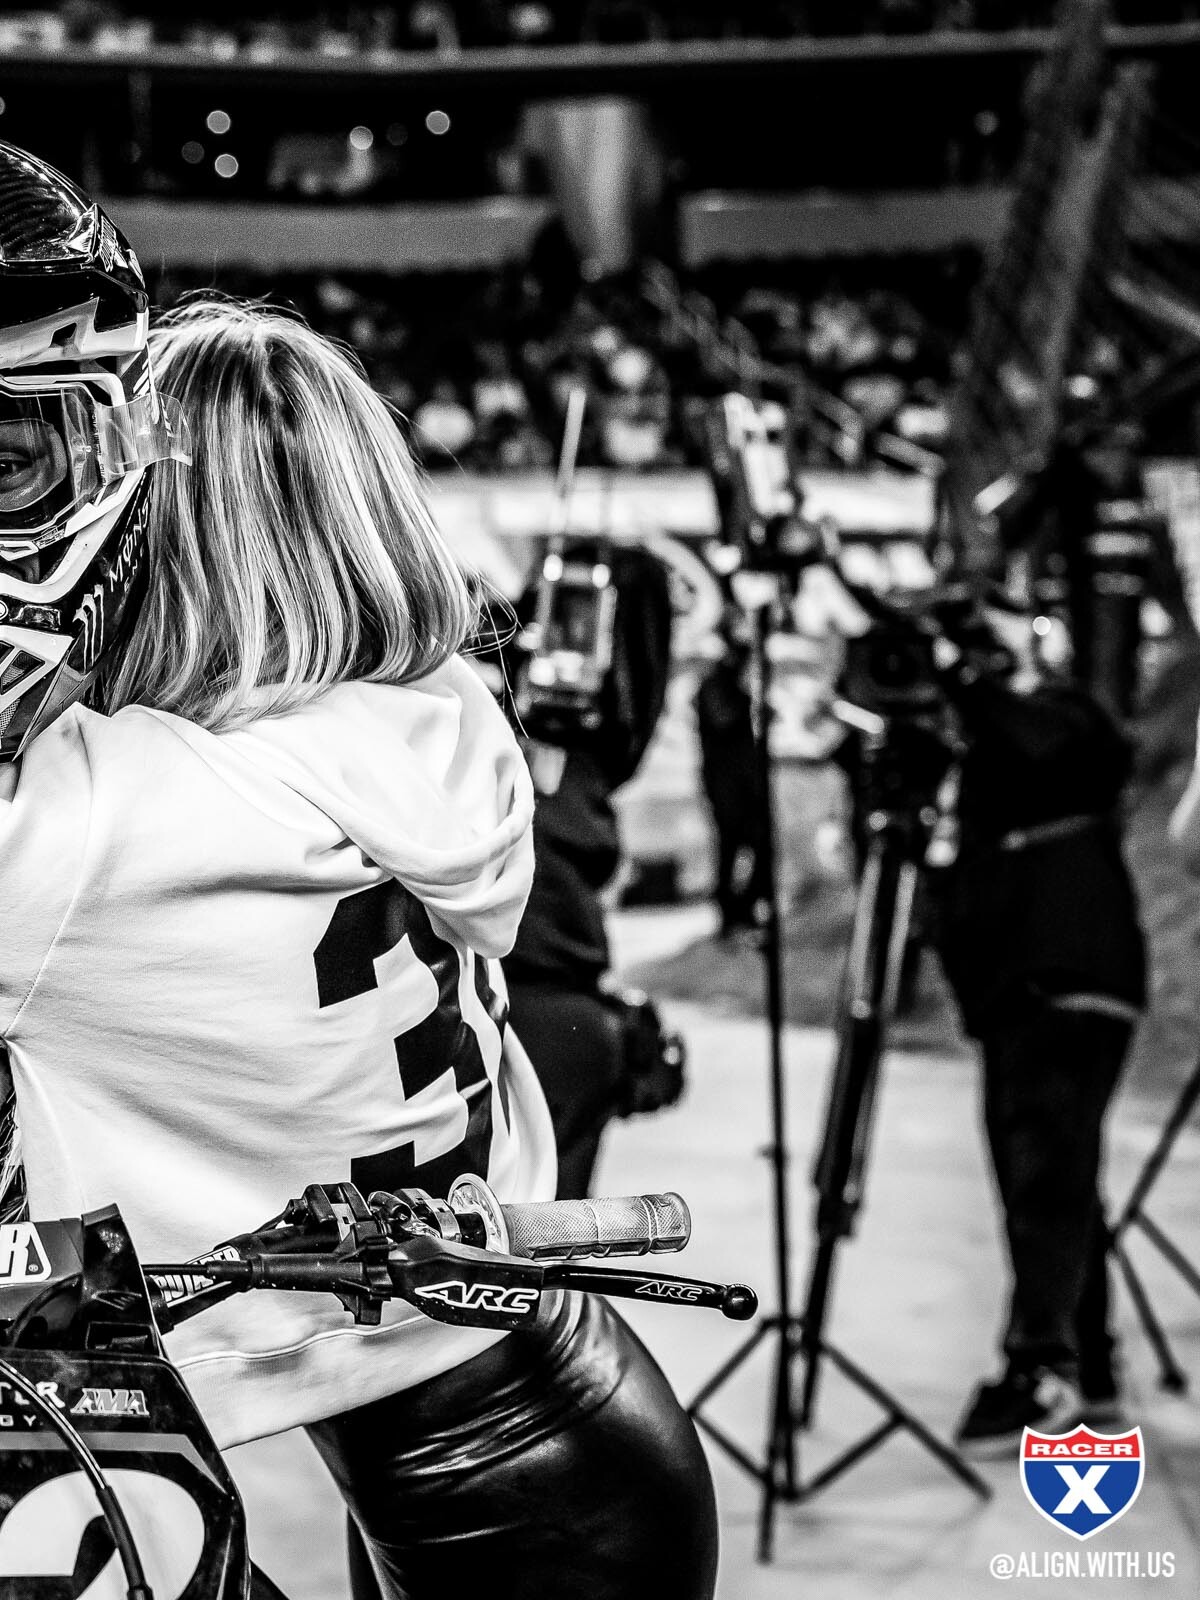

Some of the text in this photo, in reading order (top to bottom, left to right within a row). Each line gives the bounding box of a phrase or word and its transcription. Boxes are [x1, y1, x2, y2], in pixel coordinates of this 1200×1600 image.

[414, 1280, 540, 1314] ARC
[635, 1282, 703, 1301] ARC
[69, 1387, 150, 1417] AMA
